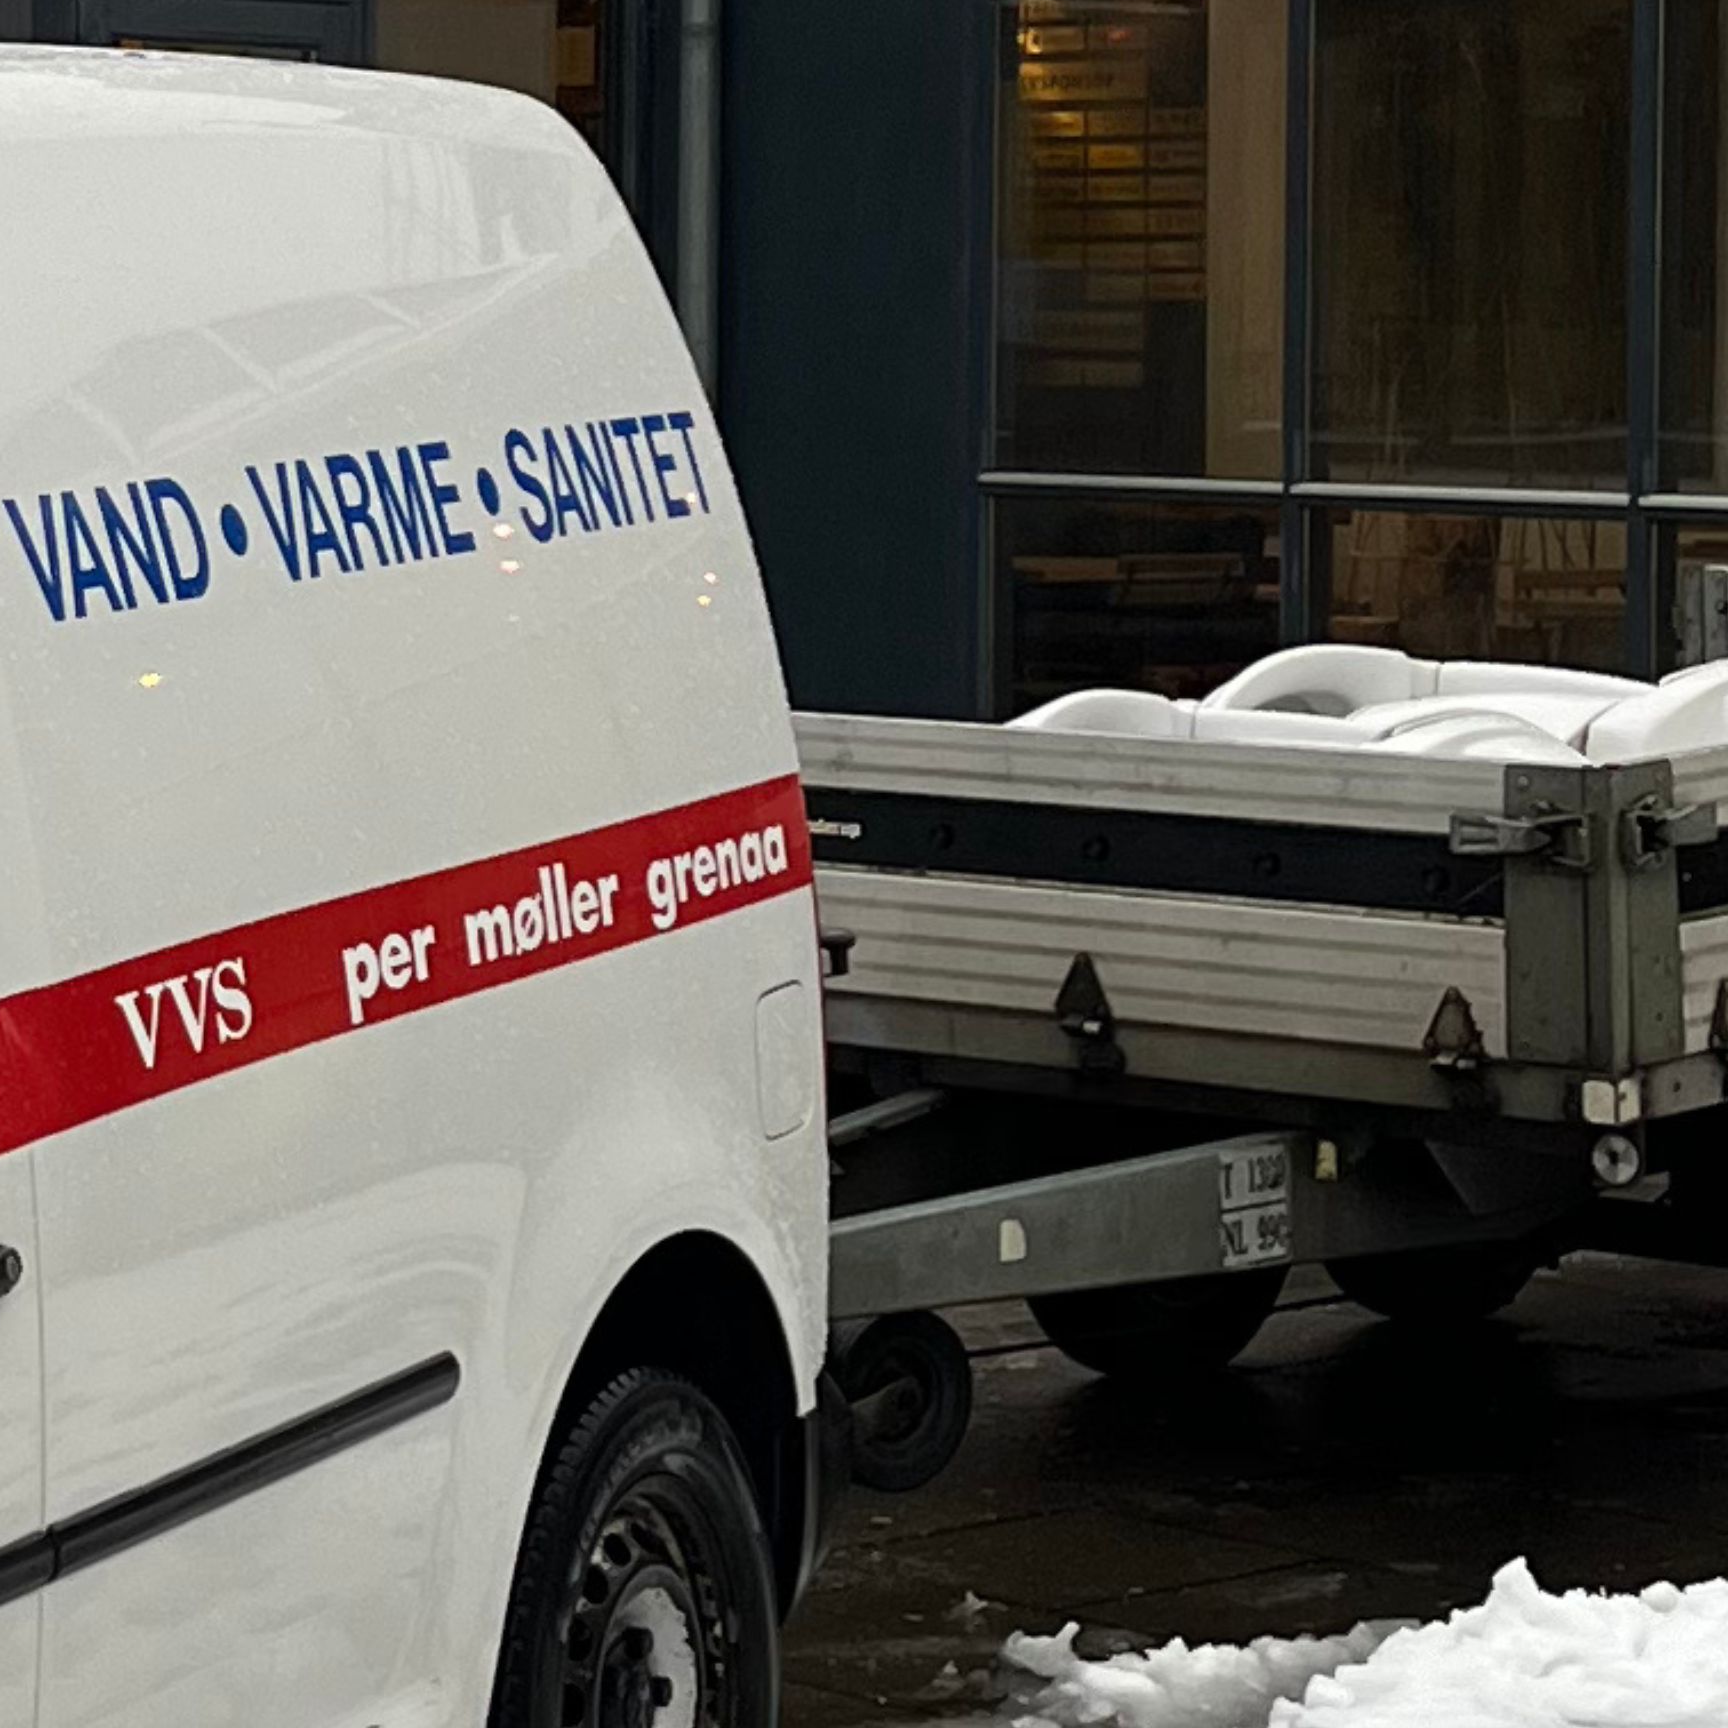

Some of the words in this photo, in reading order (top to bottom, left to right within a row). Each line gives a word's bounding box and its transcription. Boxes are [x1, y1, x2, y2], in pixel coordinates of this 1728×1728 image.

[3, 477, 210, 622] VAND
[245, 441, 476, 582] VARME
[504, 410, 712, 543] SANITET
[115, 956, 253, 1069] VVS
[342, 924, 437, 1024] per
[464, 862, 621, 967] møller
[647, 824, 788, 930] grenaa
